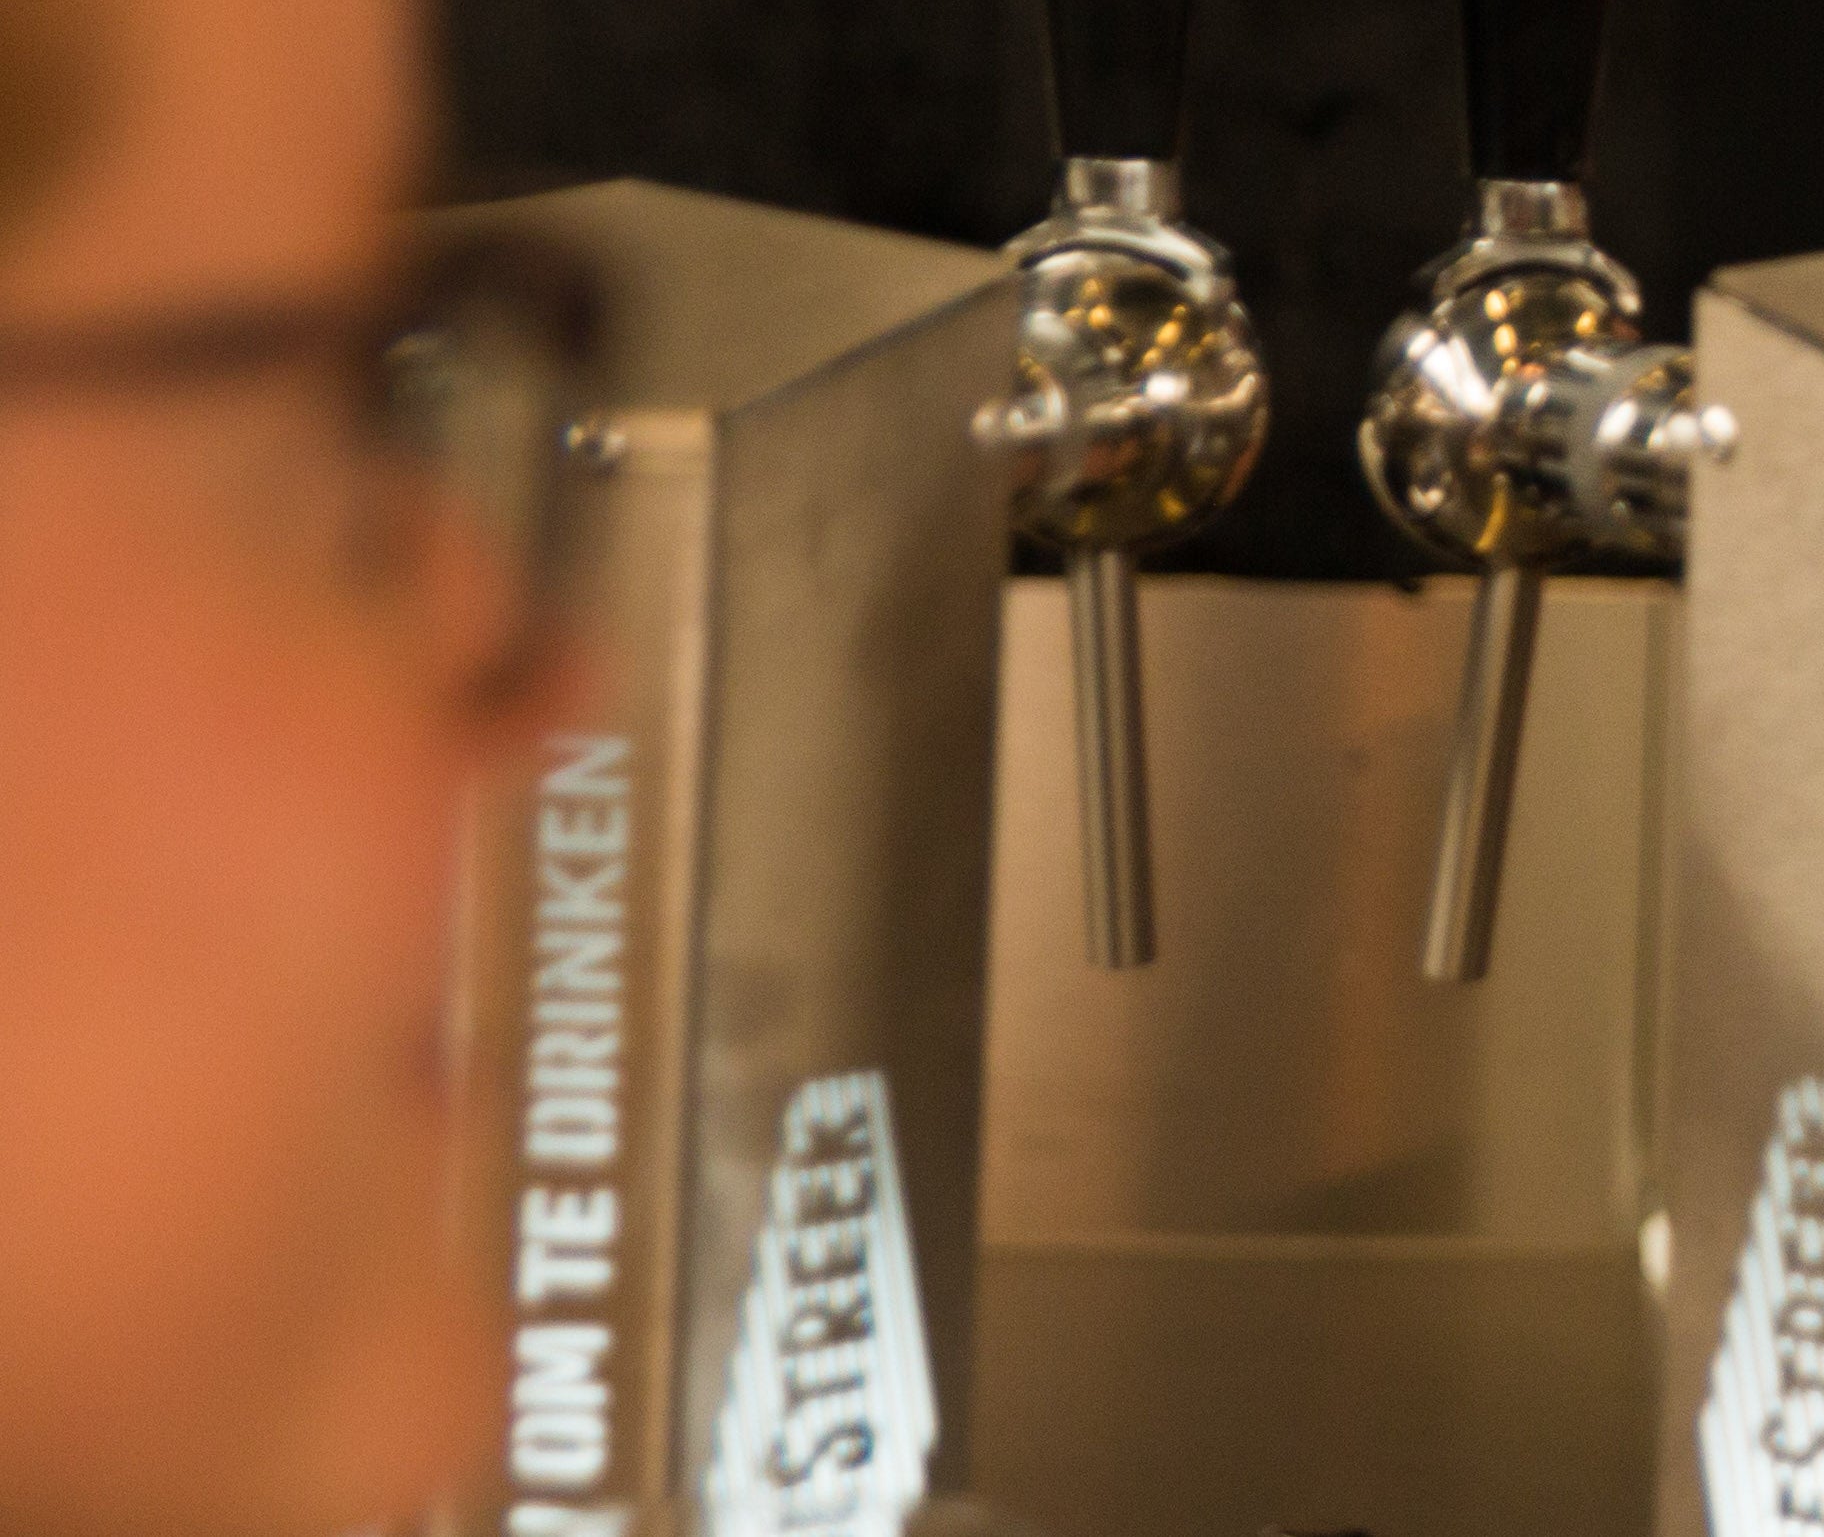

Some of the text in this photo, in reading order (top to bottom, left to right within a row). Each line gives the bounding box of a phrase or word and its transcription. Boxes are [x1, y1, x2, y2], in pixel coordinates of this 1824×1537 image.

[525, 735, 630, 1161] DRINKEN
[519, 1187, 615, 1301] TE
[511, 1324, 609, 1484] OM
